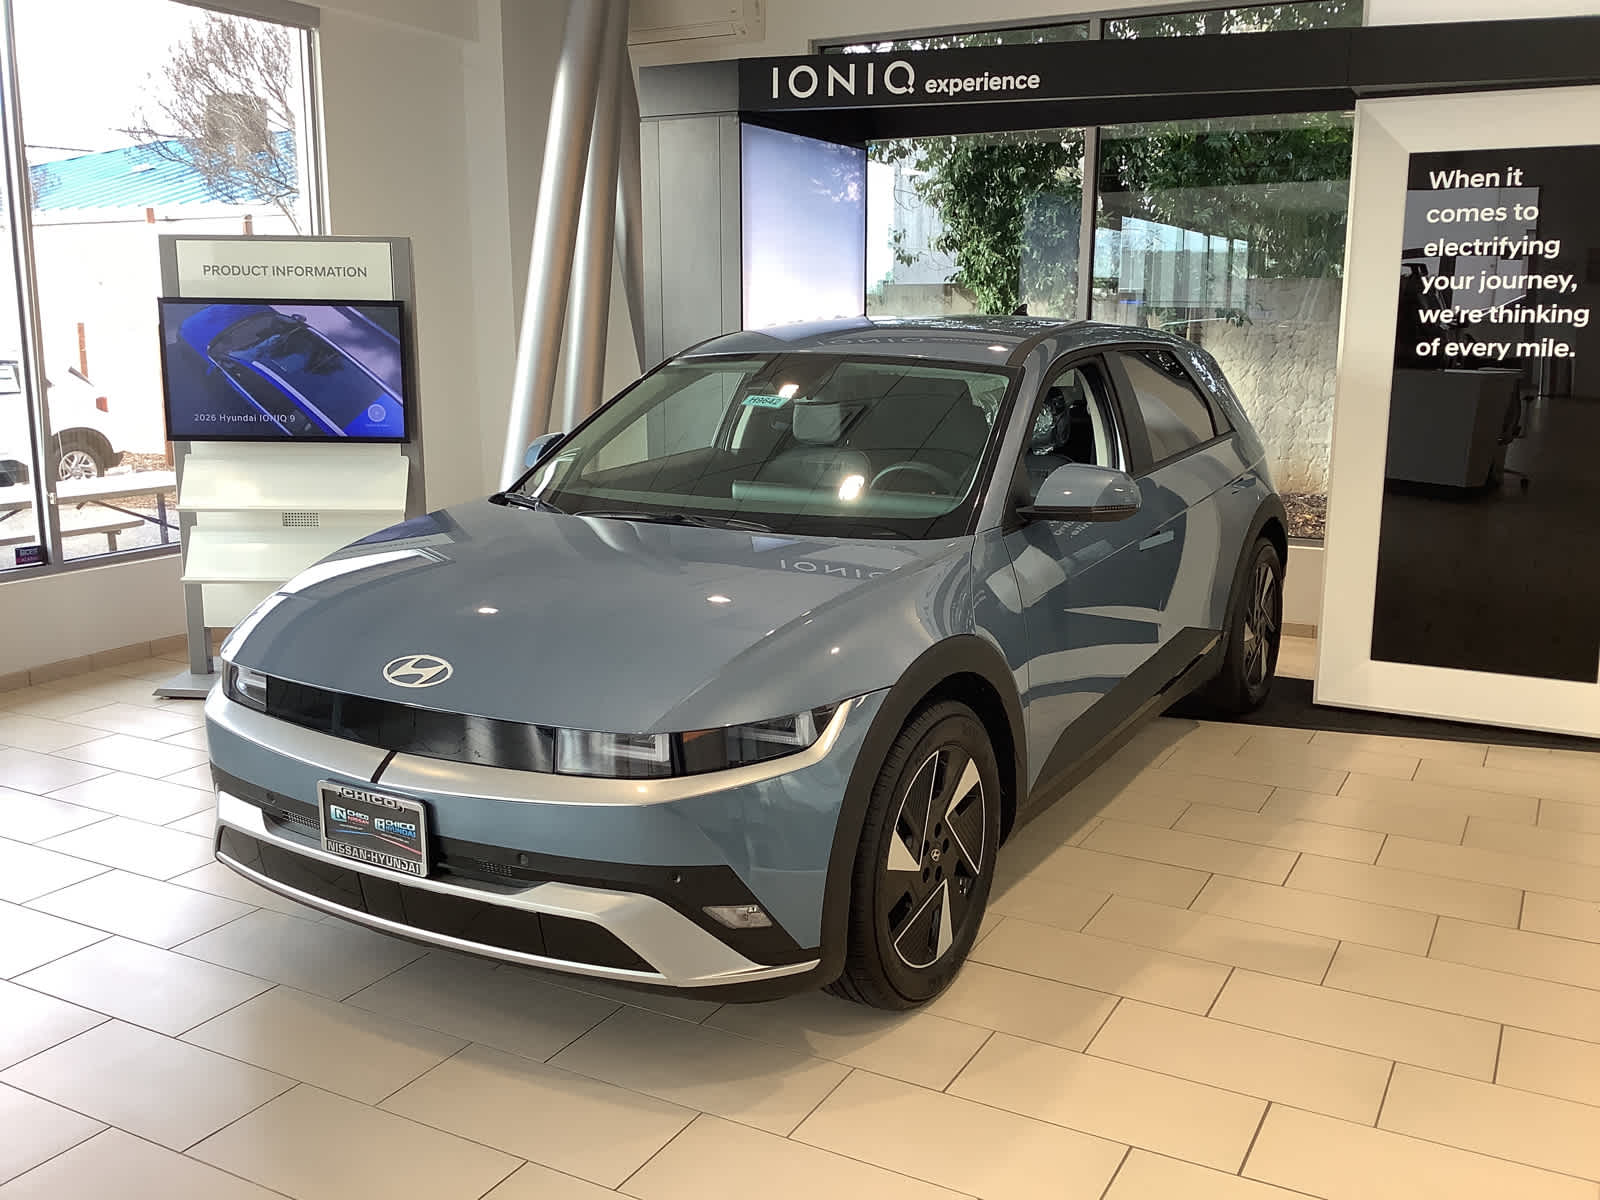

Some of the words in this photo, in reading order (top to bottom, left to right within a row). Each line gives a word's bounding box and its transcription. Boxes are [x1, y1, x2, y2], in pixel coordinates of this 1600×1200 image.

[772, 60, 915, 99] IONIQ
[924, 72, 1041, 96] experience
[1429, 169, 1500, 190] When
[1506, 166, 1524, 187] it
[1426, 205, 1508, 223] comes
[1514, 203, 1539, 221] to
[1424, 235, 1561, 260] electrifying
[202, 265, 268, 276] PRODUCT
[272, 266, 368, 278] INFORMATION
[1421, 275, 1475, 294] your
[1478, 270, 1578, 294] journey,
[1418, 306, 1483, 324] we're
[1489, 303, 1590, 328] thinking
[1415, 338, 1441, 357] of
[1444, 341, 1511, 361] every
[1516, 338, 1576, 358] mile.
[194, 413, 217, 422] 2026
[219, 413, 257, 423] Hyundai
[289, 414, 296, 423] 9
[342, 788, 396, 809] CHICO
[385, 819, 416, 831] CHICO
